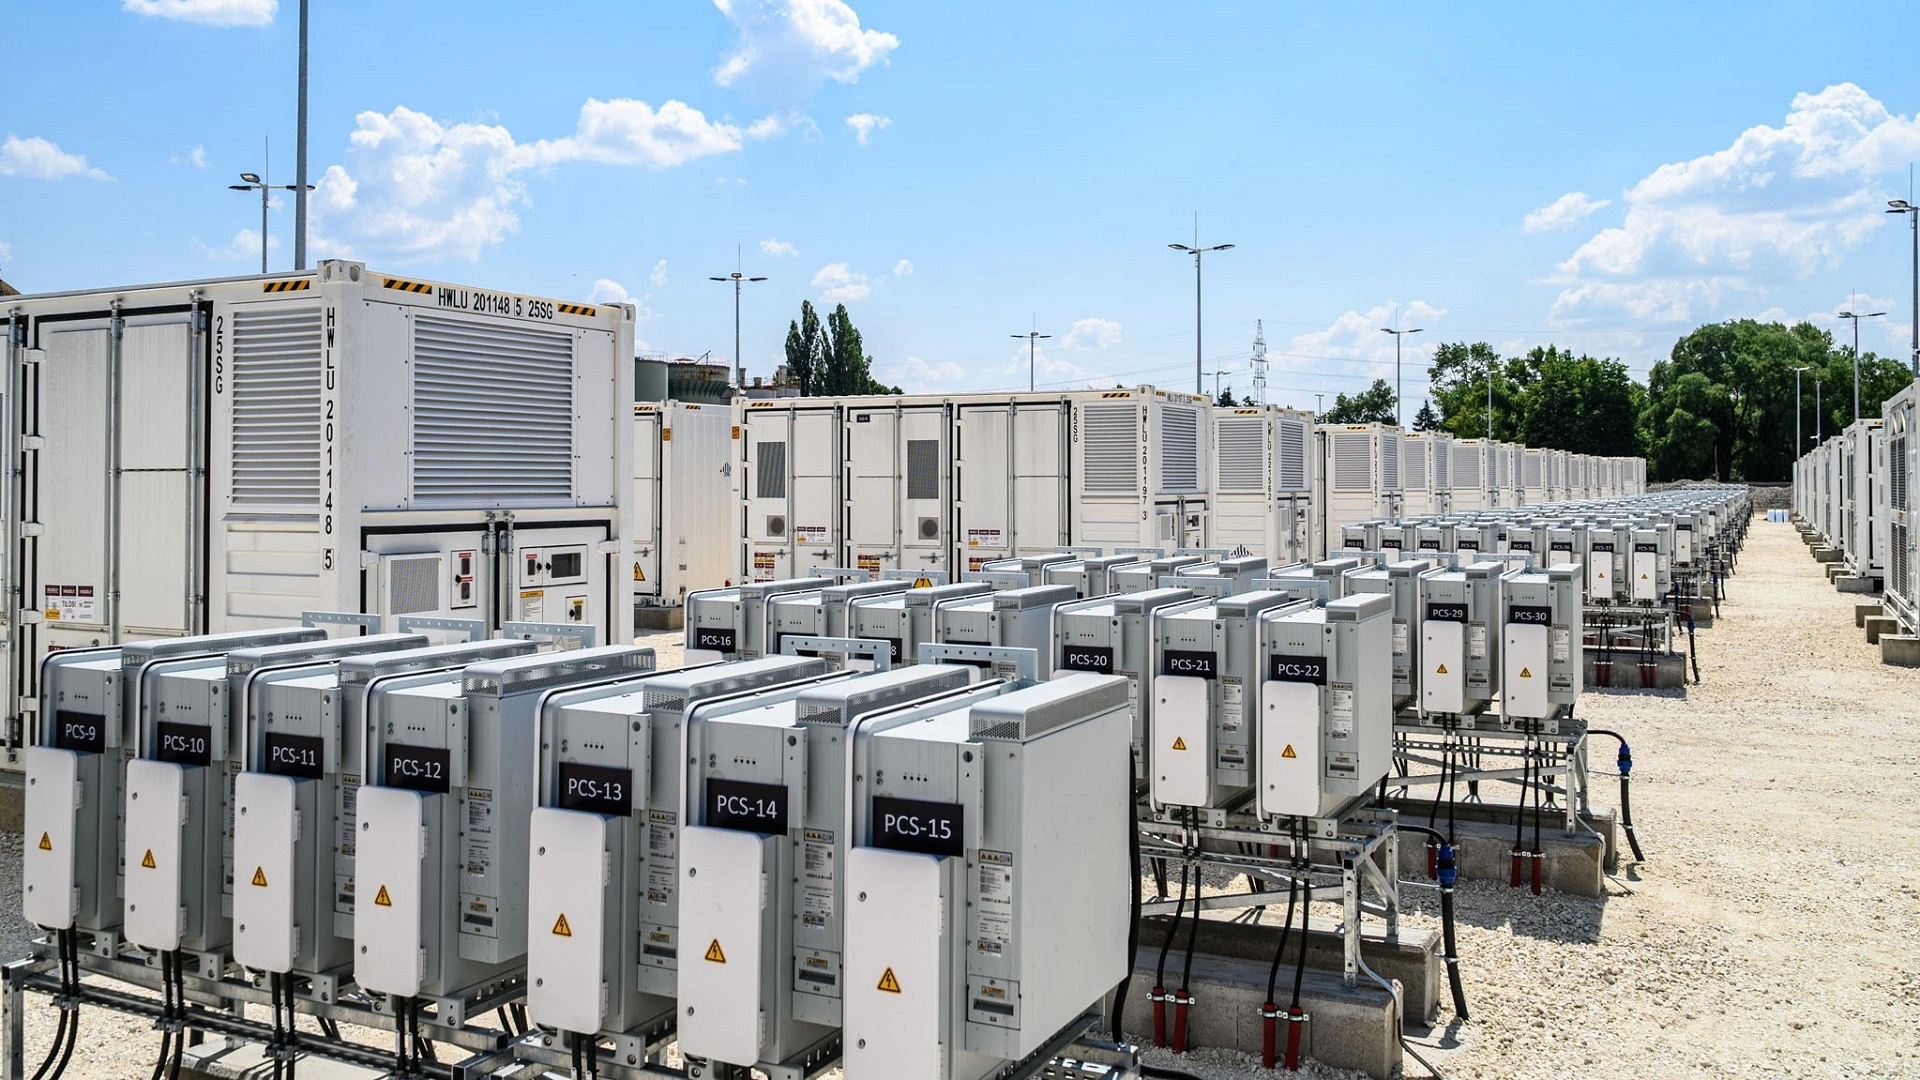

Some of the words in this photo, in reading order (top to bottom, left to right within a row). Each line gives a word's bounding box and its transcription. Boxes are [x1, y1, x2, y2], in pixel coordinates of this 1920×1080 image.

[438, 287, 468, 309] HWLU
[473, 292, 510, 314] 201148
[515, 297, 522, 316] 5
[528, 299, 553, 320] 25SG
[215, 315, 223, 394] 25SG
[326, 306, 335, 390] HWLU
[325, 400, 334, 534] 201148
[1142, 510, 1148, 520] 3
[324, 550, 333, 569] 5
[1432, 609, 1463, 618] PCS-29
[1514, 611, 1547, 621] PCS-30
[701, 634, 731, 646] PCS-16
[1069, 654, 1107, 667] PCS-20
[1170, 658, 1210, 672] PCS-21
[1277, 663, 1320, 677] PCS-22
[65, 723, 96, 741] PCS-9
[164, 734, 205, 754] PCS-10
[272, 746, 316, 766] PCS-11
[393, 758, 442, 779] PCS-12
[568, 778, 622, 801] PCS-13
[717, 795, 777, 819] PCS-14
[884, 813, 952, 839] PCS-15
